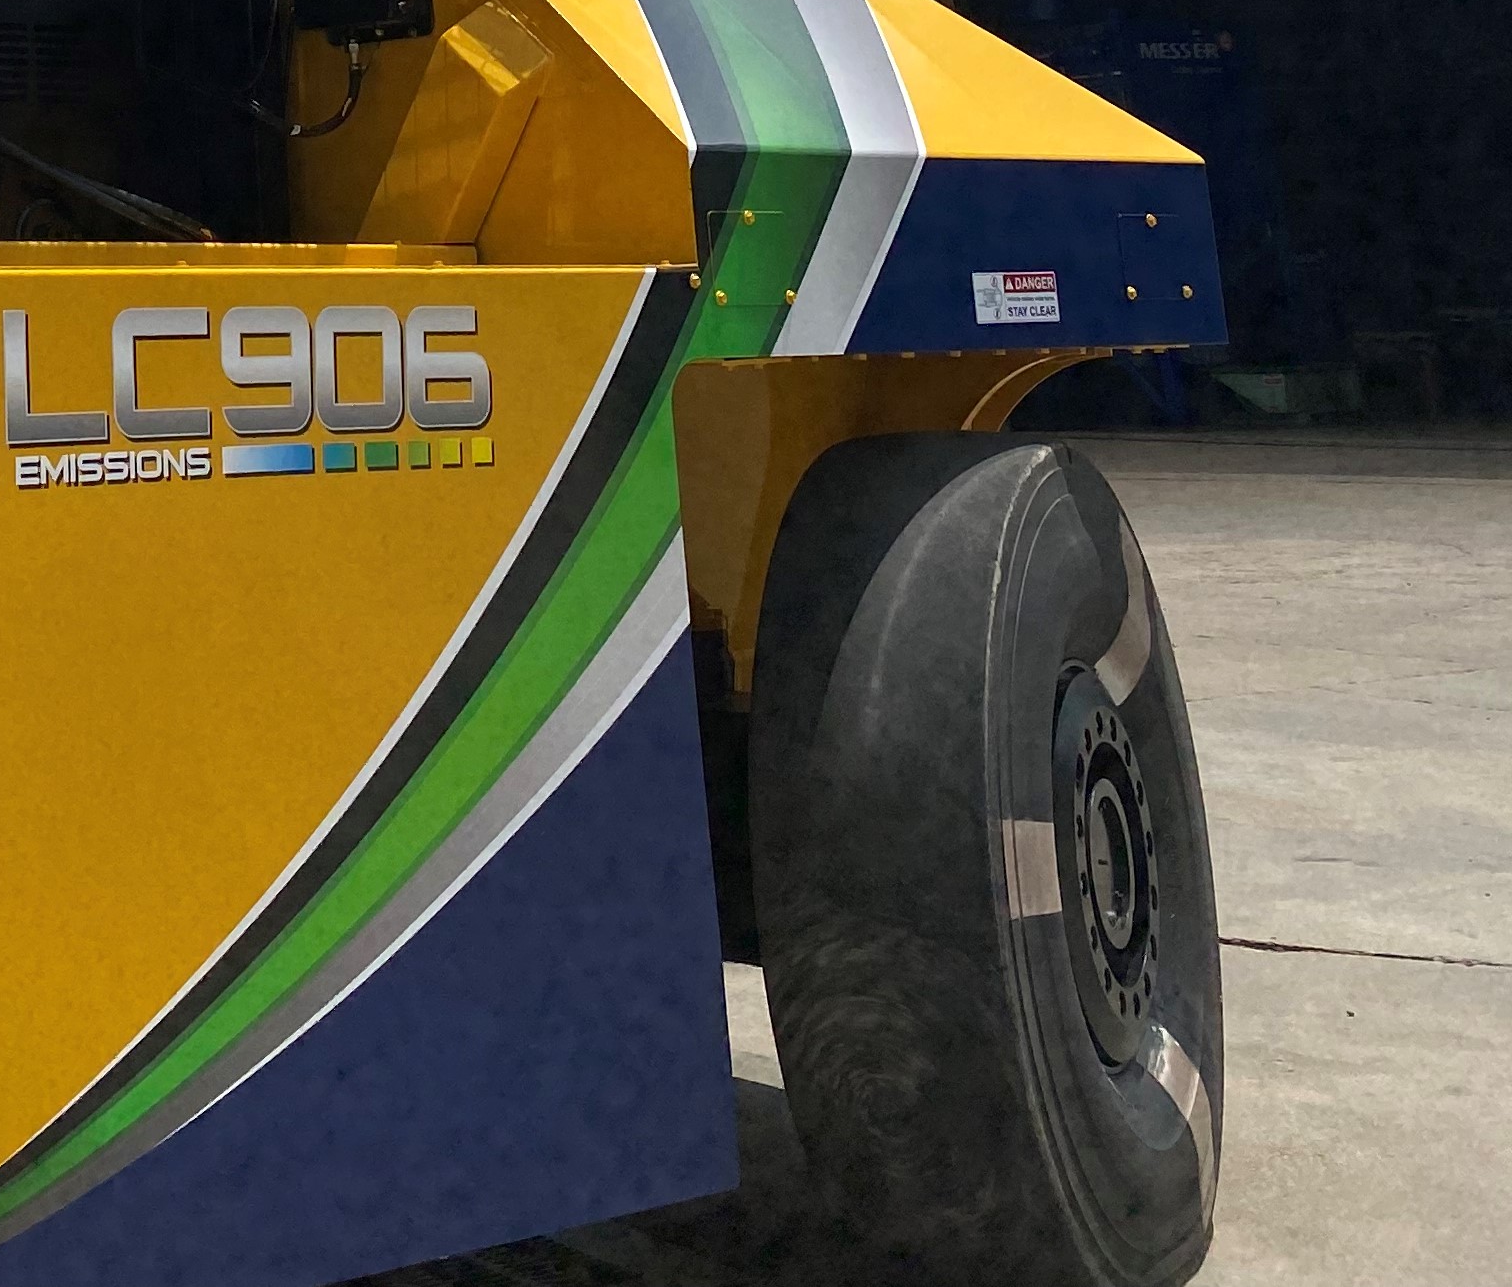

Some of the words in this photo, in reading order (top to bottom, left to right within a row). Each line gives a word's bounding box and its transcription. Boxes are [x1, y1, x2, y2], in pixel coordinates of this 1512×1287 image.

[1139, 42, 1221, 59] MESSER
[1014, 276, 1054, 290] DANGER
[1007, 306, 1028, 317] STAY
[1029, 305, 1057, 317] CLEAR
[15, 447, 212, 490] EMISSIONS
